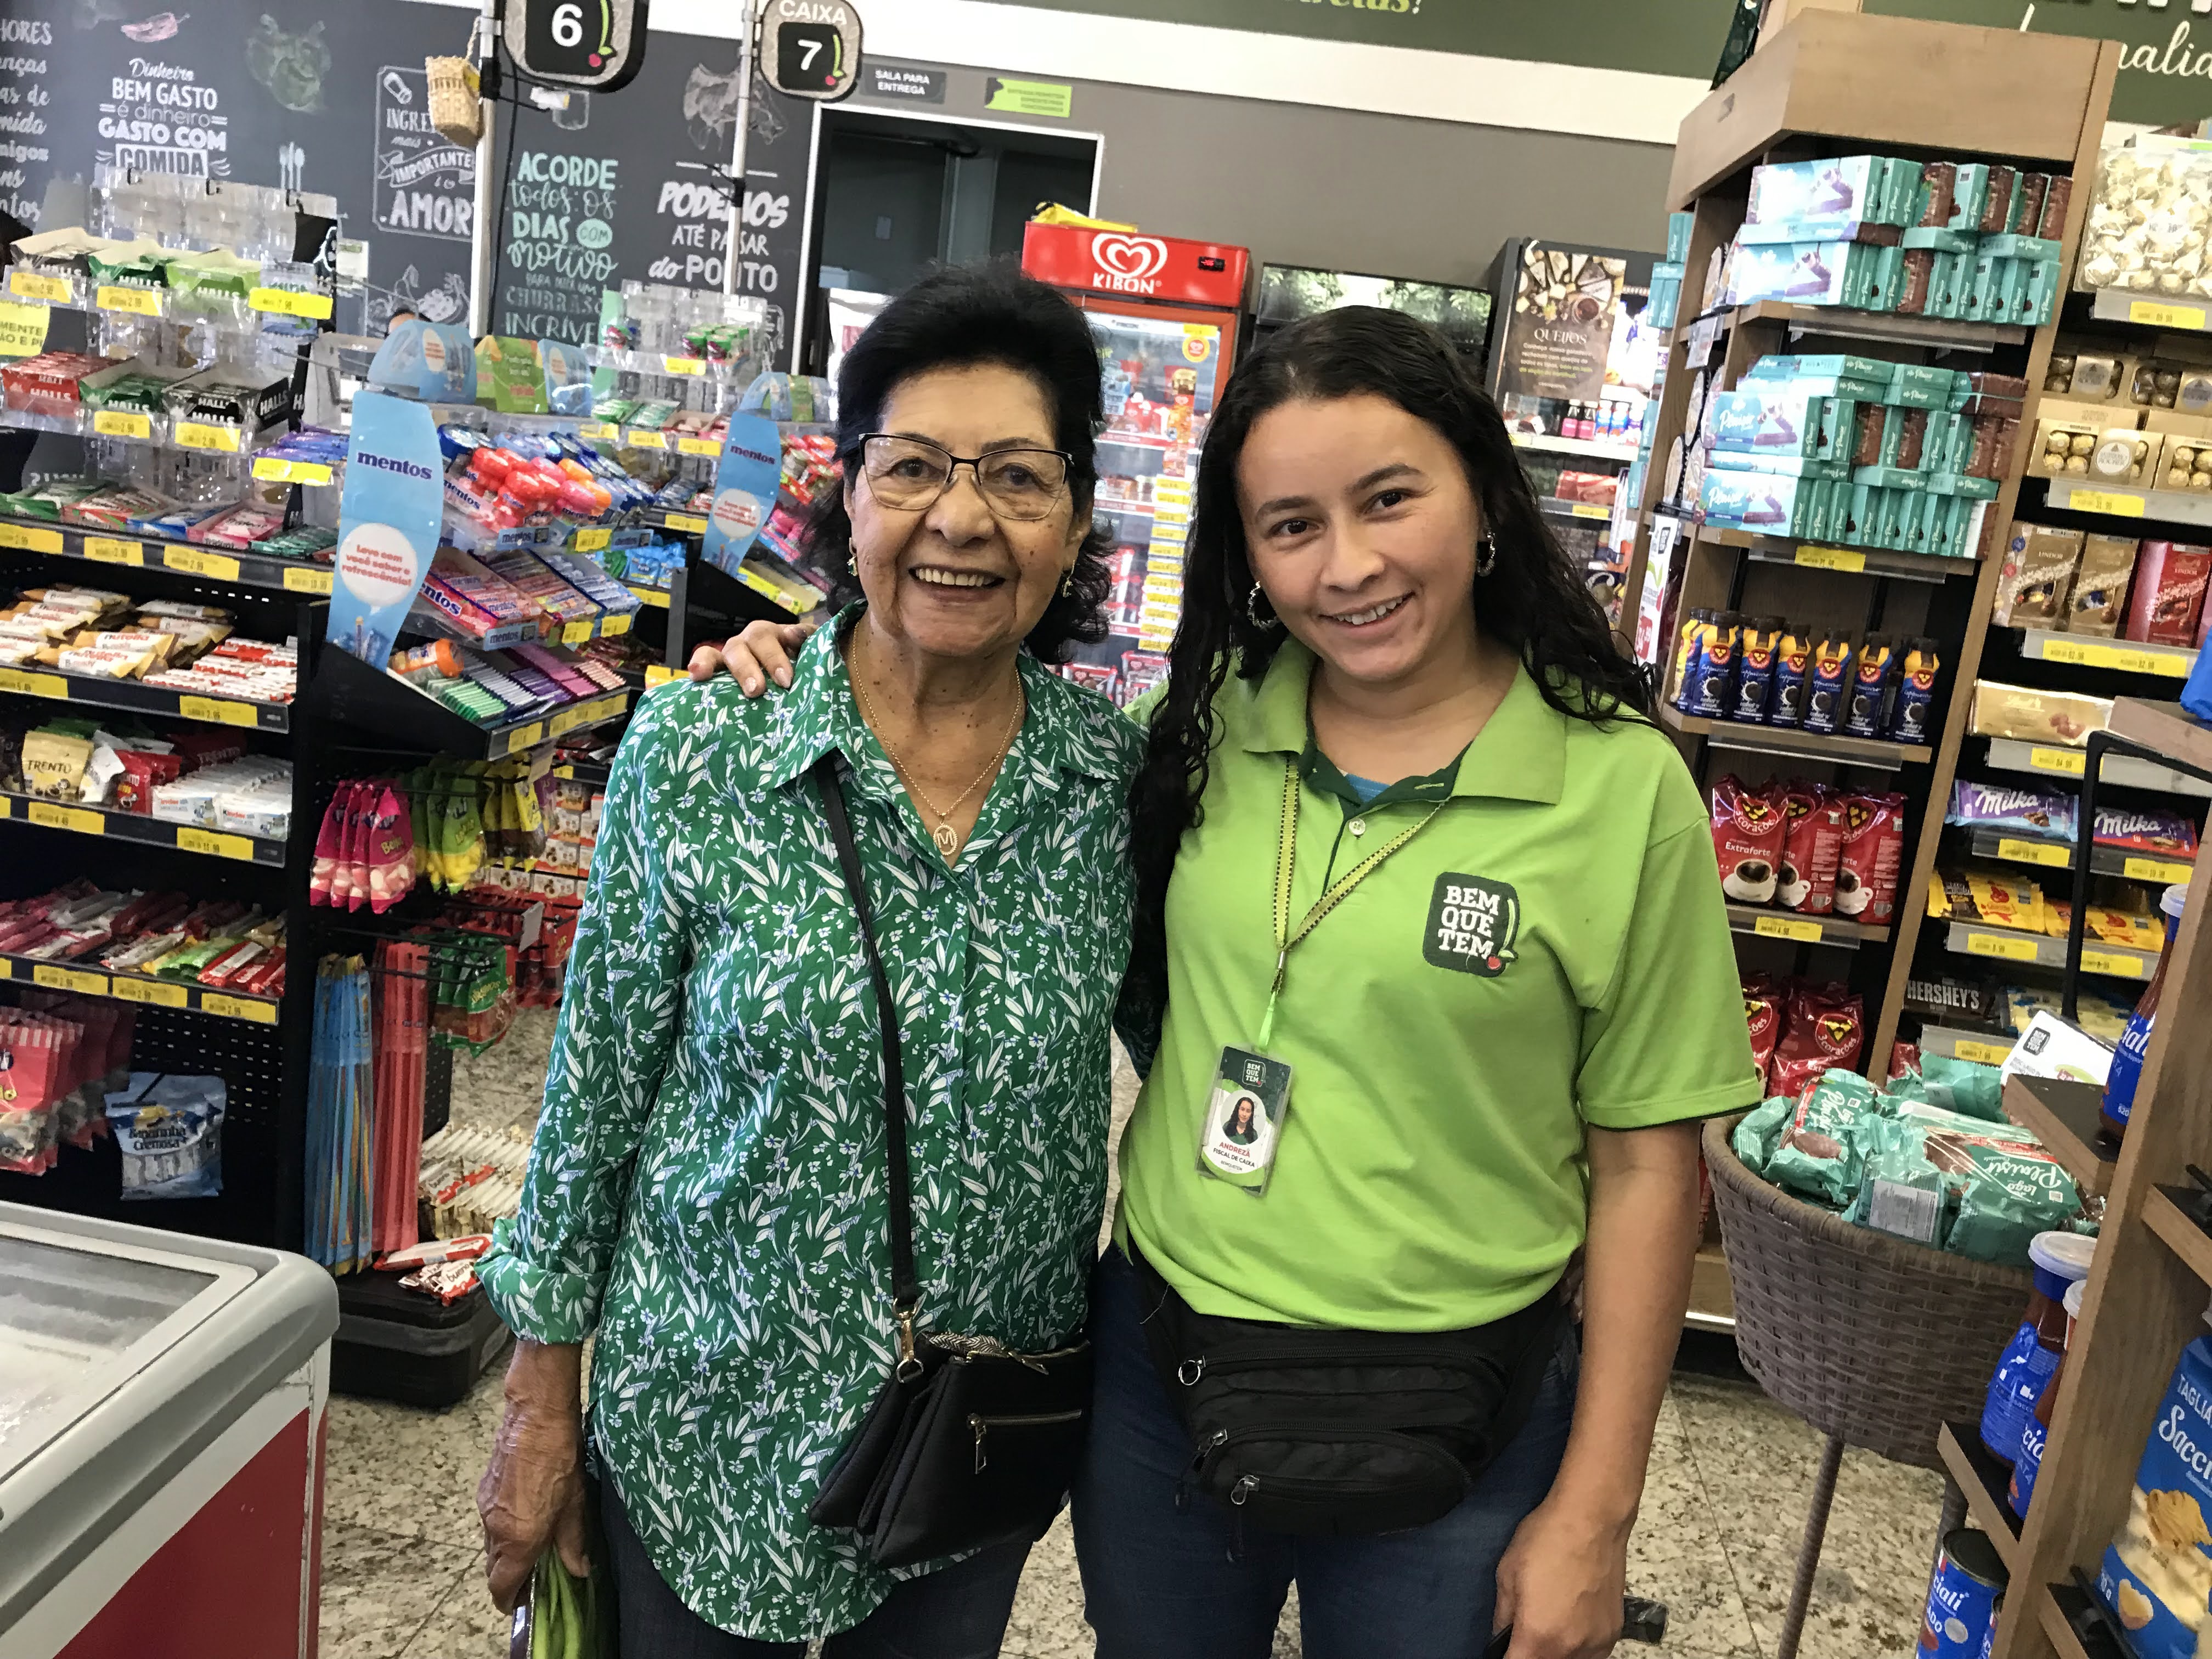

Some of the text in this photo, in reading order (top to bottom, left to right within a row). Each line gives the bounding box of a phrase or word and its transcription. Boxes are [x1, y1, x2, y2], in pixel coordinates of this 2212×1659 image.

[779, 0, 848, 25] CAIXA
[551, 4, 583, 47] 6
[0, 57, 47, 77] nças
[797, 39, 822, 71] 7
[128, 58, 195, 82] Dinheiro
[875, 69, 930, 84] SALA PARA
[112, 77, 218, 110] BEM GASTO
[877, 81, 926, 95] ENTREGA
[134, 103, 212, 128] dinheiro
[386, 108, 436, 133] INGRE
[98, 117, 227, 152] GASTO COM
[393, 151, 472, 183] IMPORTANTE
[517, 151, 618, 190] ACORDE
[509, 179, 617, 220] todos os
[657, 180, 790, 228] PODEOS
[388, 189, 472, 236] AMOR
[512, 211, 611, 244] DIAS COM
[672, 220, 769, 257] ATÉ PASAR
[506, 240, 620, 281] motivo
[119, 275, 161, 287] HALLS
[648, 254, 779, 293] do POTO
[1092, 272, 1155, 295] KIBON
[1533, 328, 1587, 345] QUEIJOS
[30, 387, 72, 403] HALLS
[108, 399, 150, 412] HALLS
[260, 390, 289, 416] HALLS
[356, 450, 433, 481] mentos
[729, 443, 776, 466] mentos
[501, 530, 532, 544] mentos
[381, 551, 403, 563] com
[488, 631, 520, 645] mentos
[27, 760, 72, 774] TRENTO
[1974, 790, 2039, 816] Milka
[2094, 812, 2163, 837] Milka
[936, 831, 953, 849] M
[1725, 841, 1771, 857] Extraforte
[1443, 885, 1500, 916] BEM
[1441, 906, 1494, 938] QUE
[1437, 928, 1494, 960] TEM
[1906, 979, 1979, 1011] HERSHEY'S
[1245, 1074, 1260, 1084] TEM
[1246, 1062, 1261, 1071] BEM
[1246, 1069, 1260, 1077] QUE
[1213, 1148, 1231, 1160] FISCAL
[1239, 1156, 1255, 1167] CAIXA
[1219, 1142, 1250, 1158] ANDREZA
[1983, 1159, 2062, 1189] Plaisir
[2007, 1180, 2037, 1197] Lago
[446, 1262, 470, 1283] bueno
